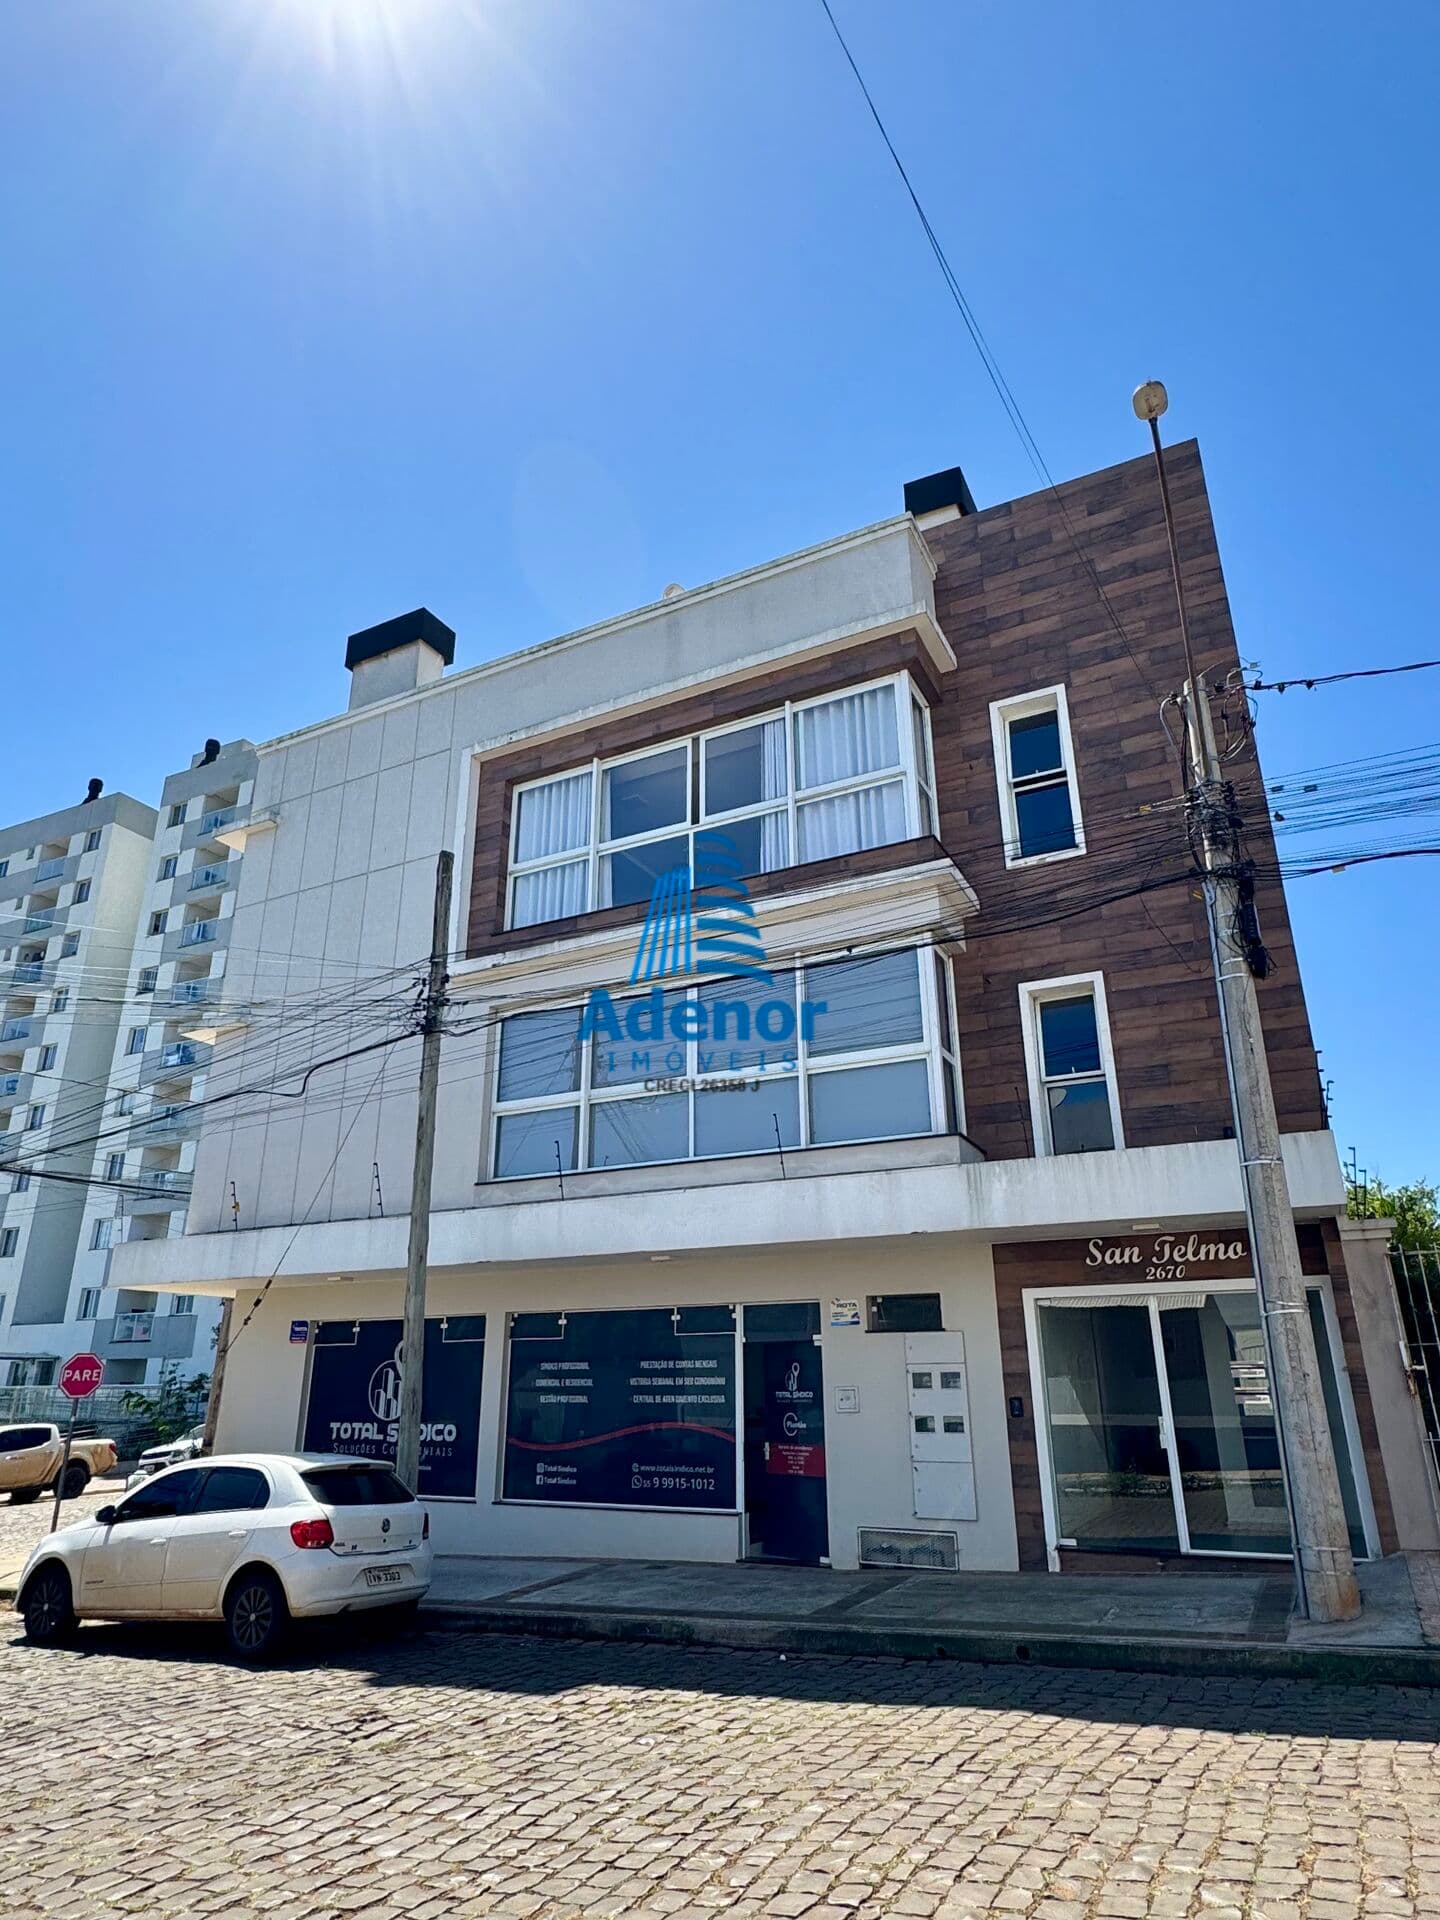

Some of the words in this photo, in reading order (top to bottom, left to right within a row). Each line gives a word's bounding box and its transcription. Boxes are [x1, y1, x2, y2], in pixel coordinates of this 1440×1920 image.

[1085, 1238, 1143, 1266] San
[1152, 1233, 1248, 1264] Telmo
[1145, 1264, 1186, 1280] 2670
[63, 1369, 101, 1382] PARE
[329, 1422, 384, 1440] TOTAL
[386, 1422, 457, 1442] SDICO
[653, 1477, 660, 1488] 9
[662, 1477, 715, 1490] 9915-1012
